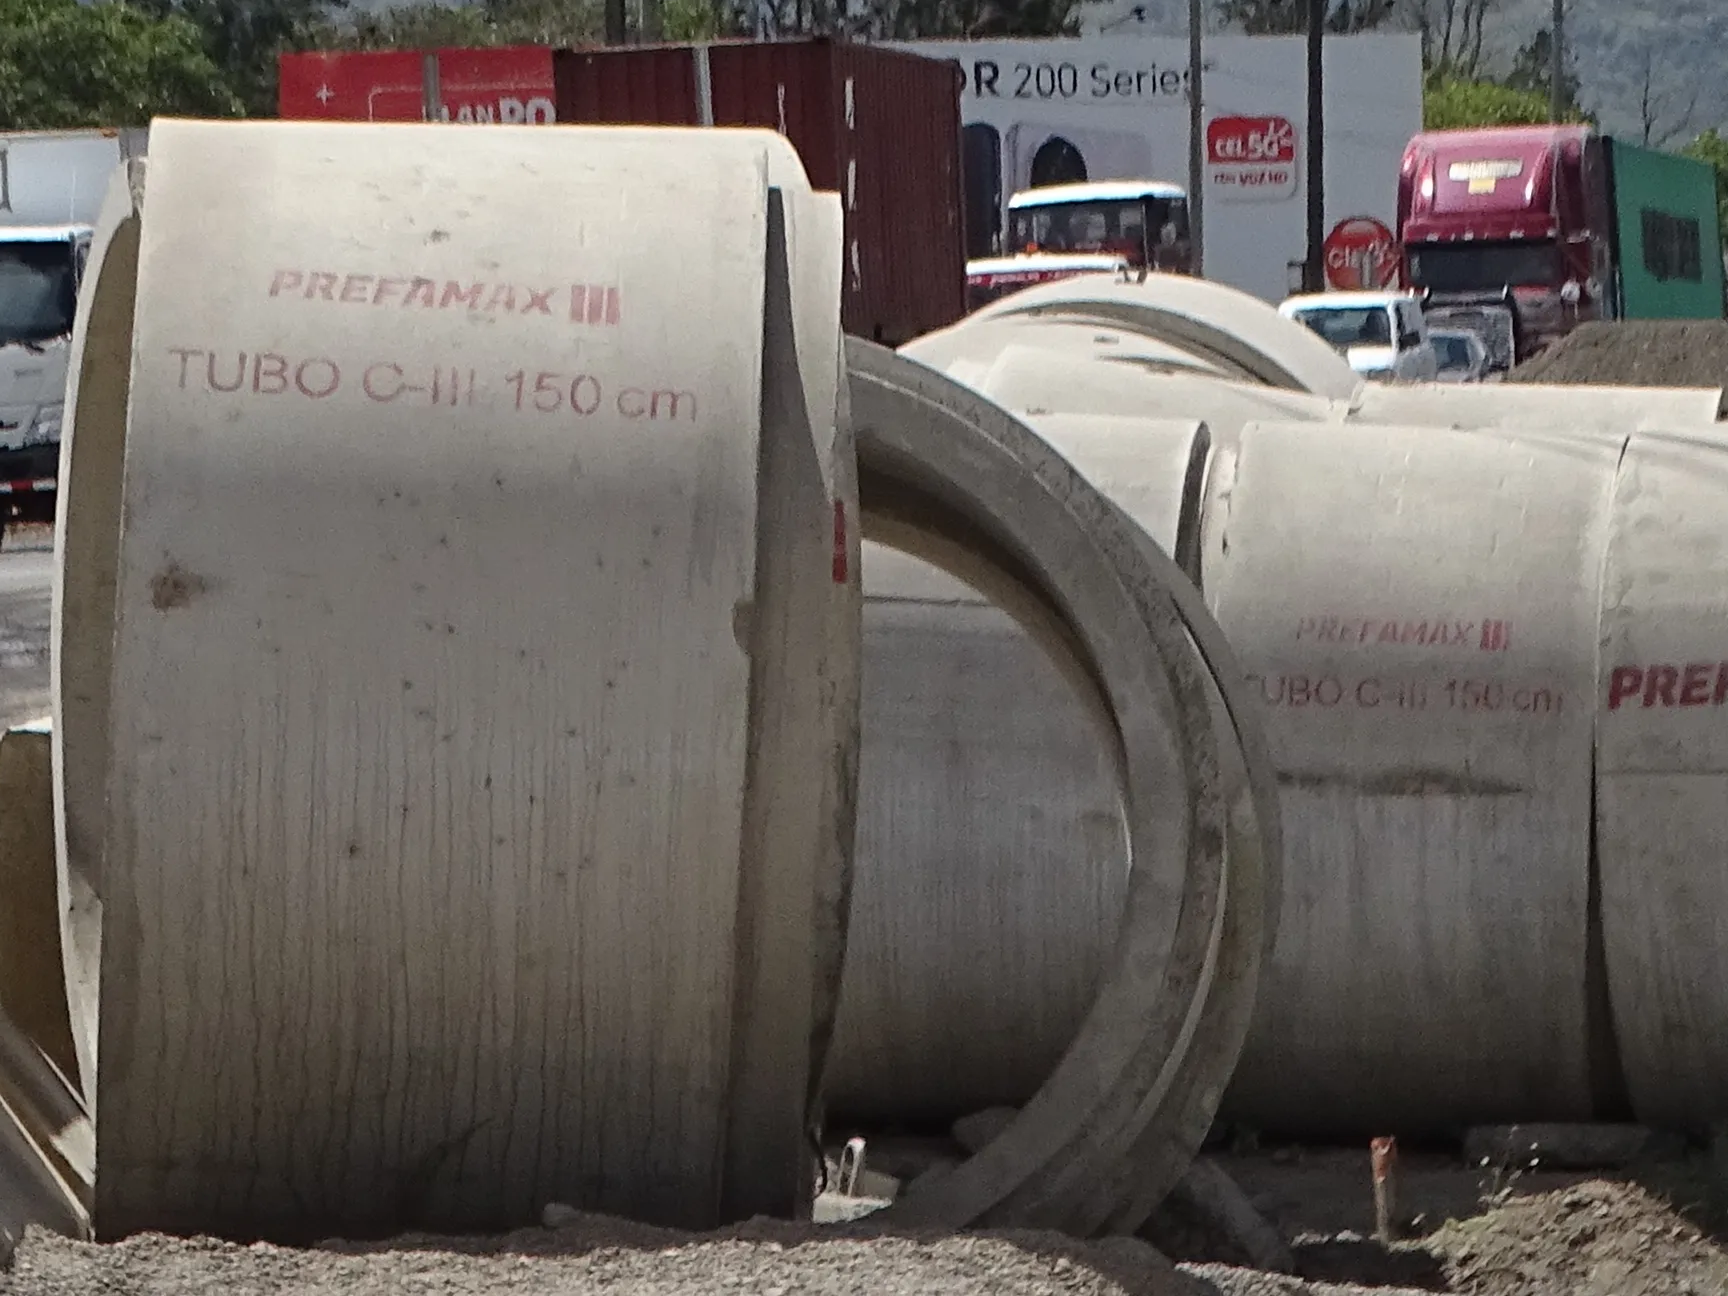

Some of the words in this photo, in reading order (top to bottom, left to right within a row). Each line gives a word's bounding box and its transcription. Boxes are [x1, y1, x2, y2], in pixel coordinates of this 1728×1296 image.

[1013, 62, 1078, 99] 200
[268, 267, 554, 316] PREFAMAX
[168, 347, 341, 399] TUBO
[362, 361, 477, 408] C-III
[505, 368, 603, 417] 150
[616, 386, 698, 423] cm
[1295, 616, 1474, 646] PREFAMAX
[1443, 677, 1505, 711] 150
